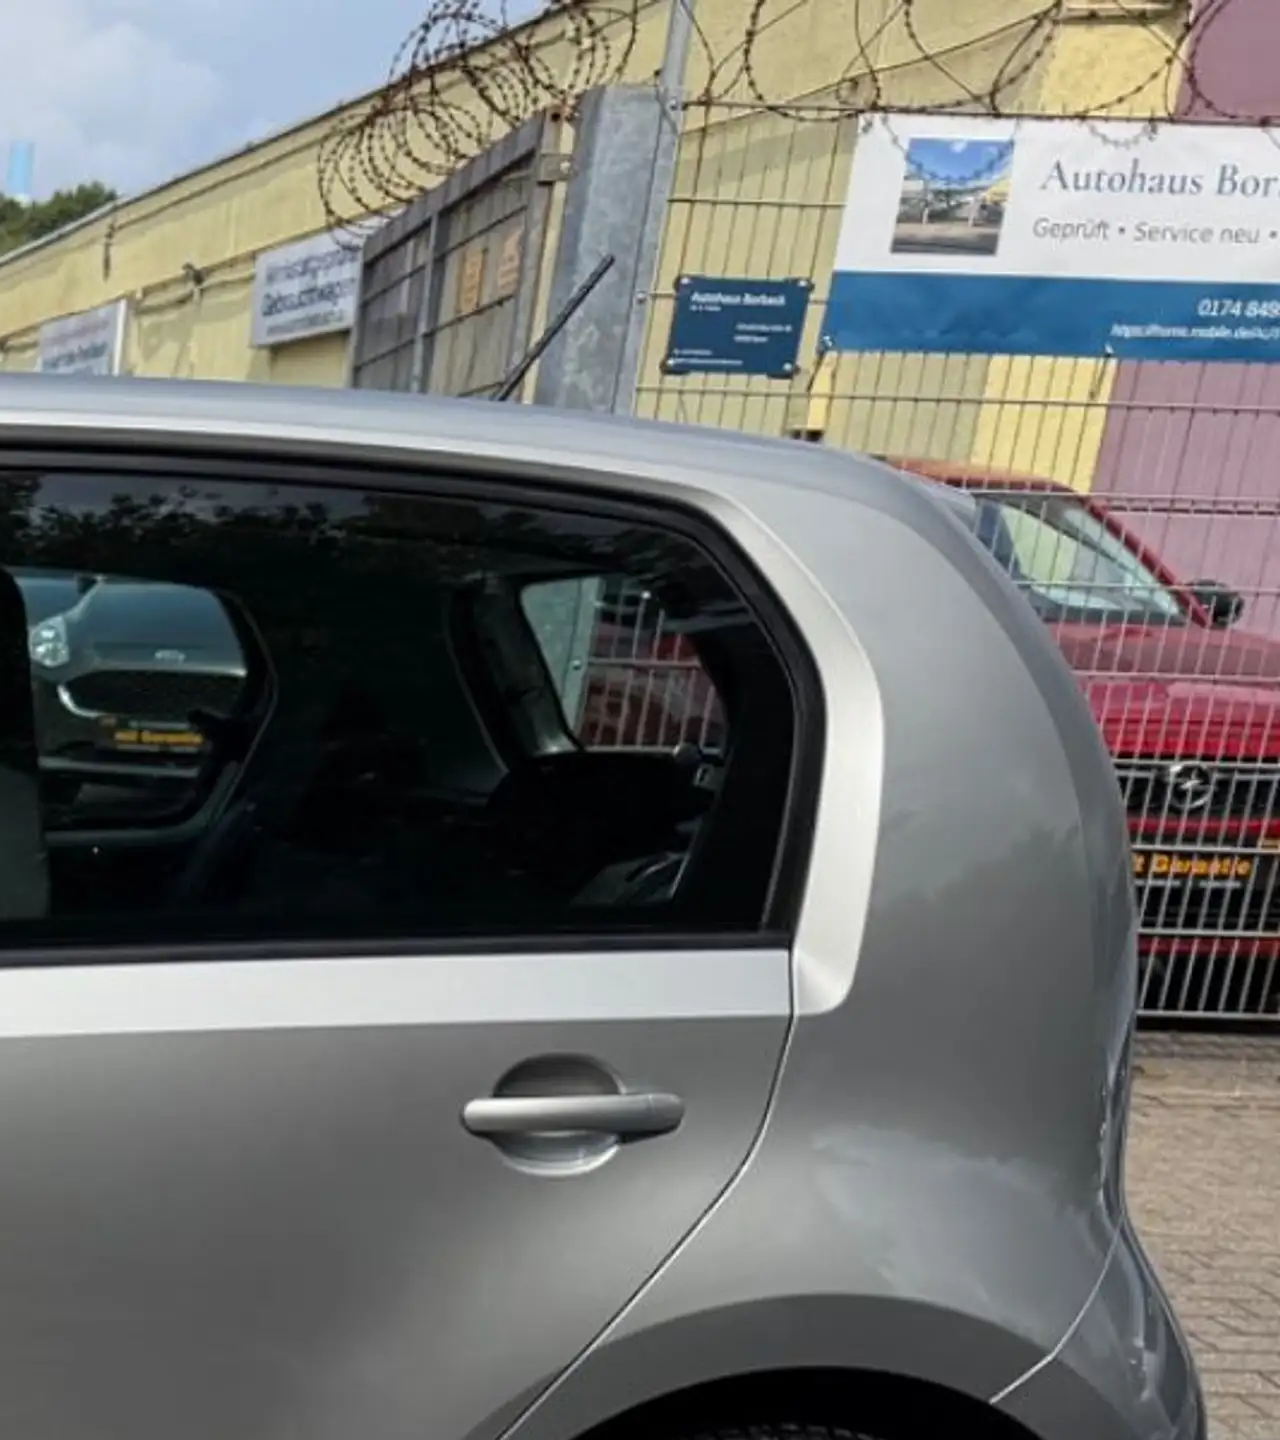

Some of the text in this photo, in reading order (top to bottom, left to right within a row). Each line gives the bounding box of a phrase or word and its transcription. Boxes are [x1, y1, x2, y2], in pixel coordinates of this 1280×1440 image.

[1040, 157, 1280, 199] Autohaus Bor
[1032, 216, 1261, 244] Geprüft Service neu
[1197, 298, 1241, 317] 0174
